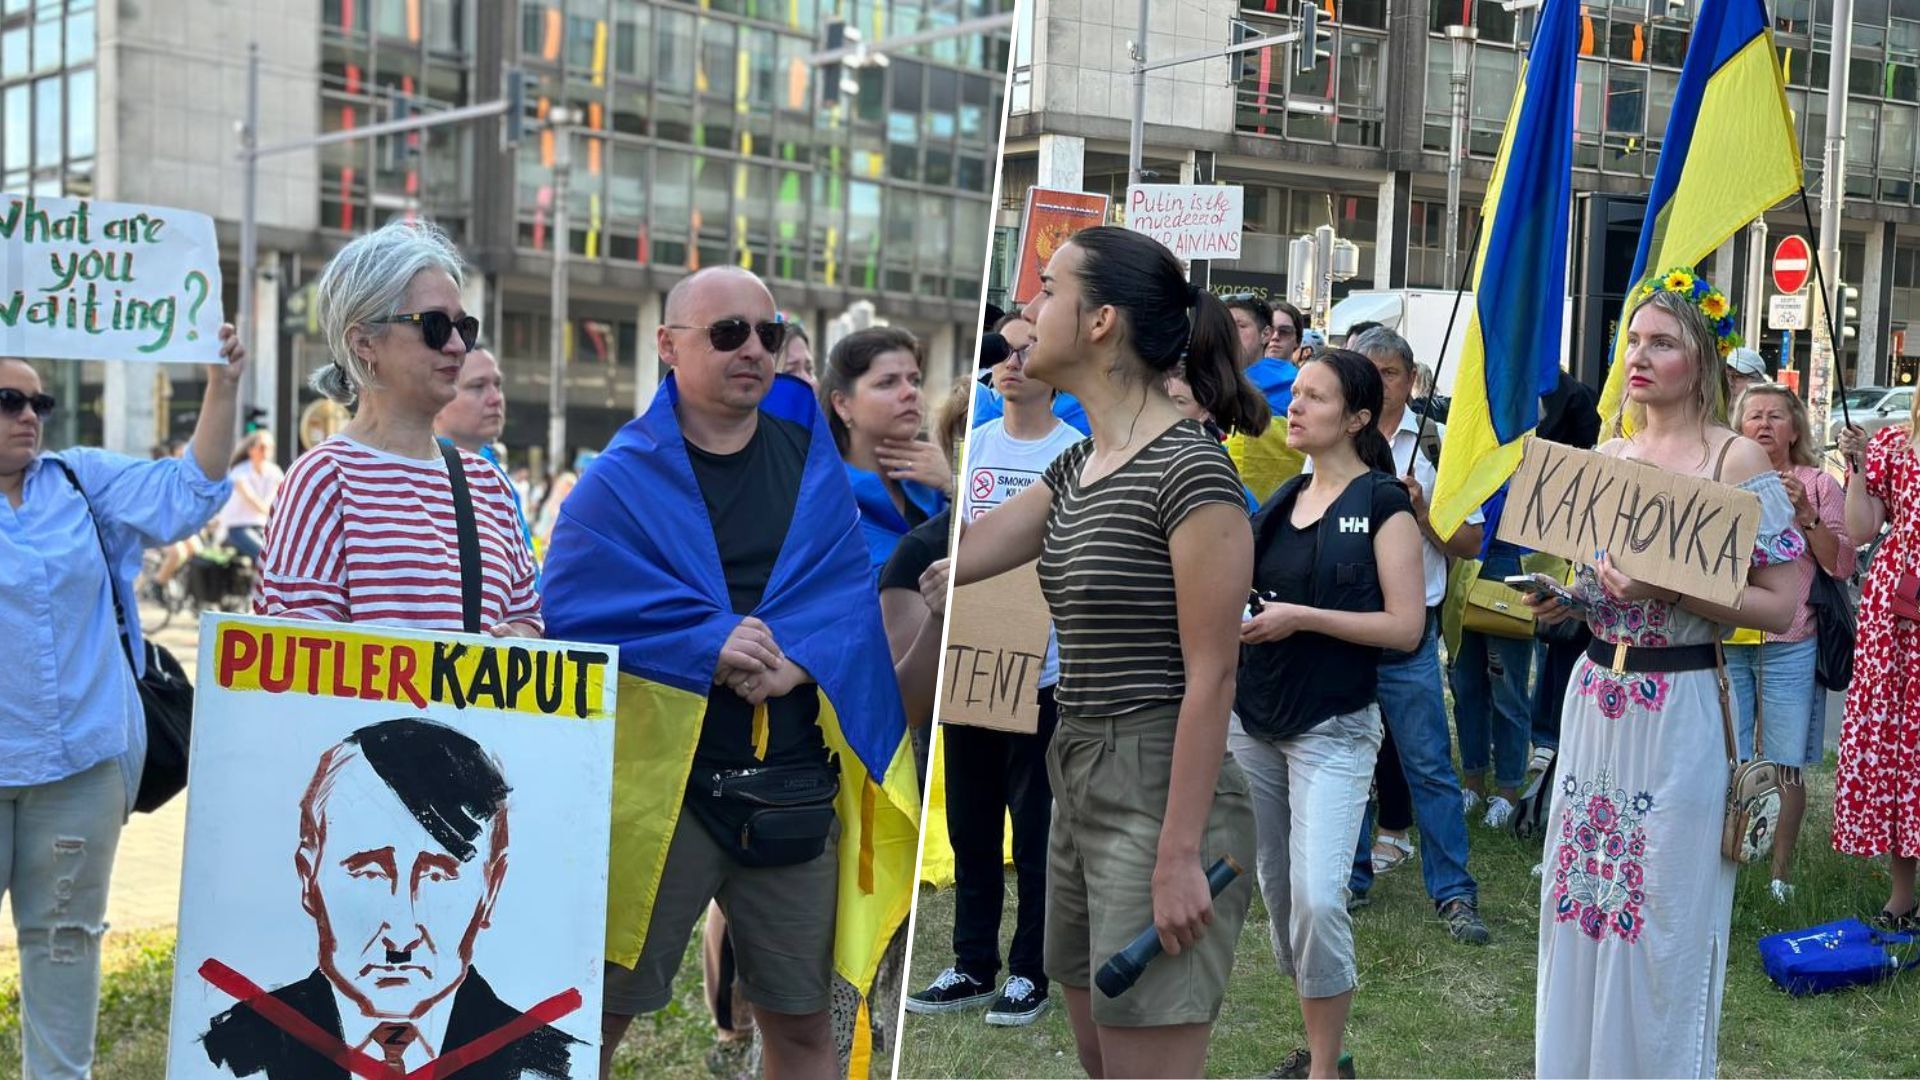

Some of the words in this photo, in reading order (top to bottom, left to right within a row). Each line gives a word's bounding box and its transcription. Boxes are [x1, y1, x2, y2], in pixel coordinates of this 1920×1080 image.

[1133, 190, 1183, 212] Putin
[1190, 193, 1201, 210] is
[1206, 191, 1231, 212] the
[104, 213, 165, 244] are
[1211, 211, 1224, 225] of
[38, 249, 136, 292] you
[1339, 516, 1369, 533] HH
[1520, 445, 1743, 589] KAKHOVKA
[219, 629, 428, 709] PUTLER
[430, 641, 609, 719] KAPUT
[947, 645, 1043, 718] TENT
[384, 1026, 409, 1045] Z
